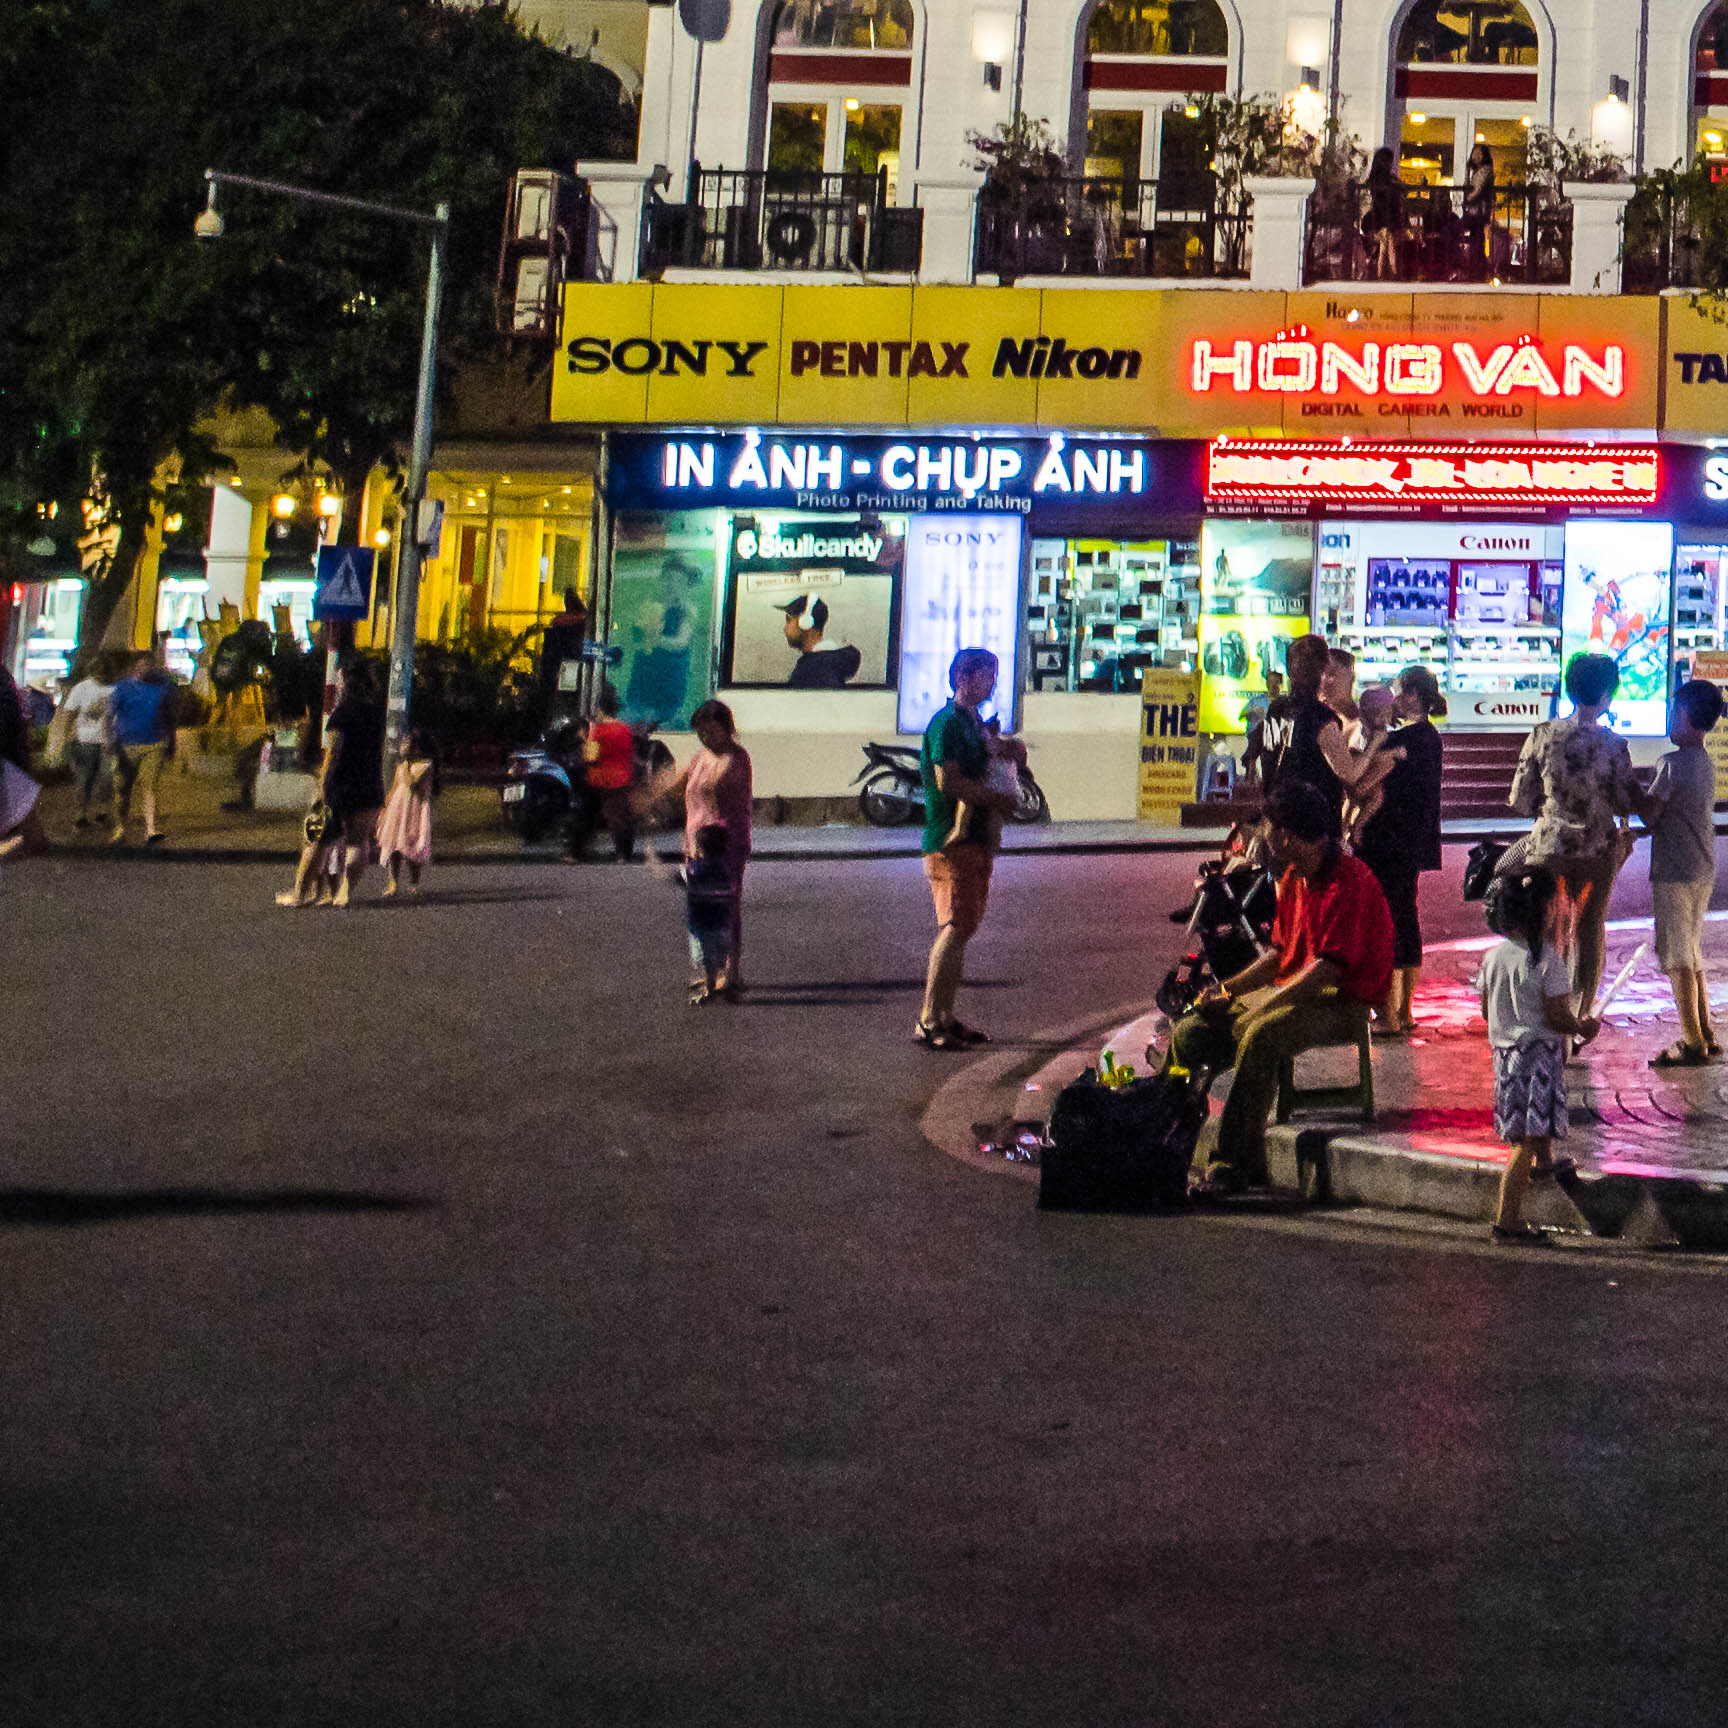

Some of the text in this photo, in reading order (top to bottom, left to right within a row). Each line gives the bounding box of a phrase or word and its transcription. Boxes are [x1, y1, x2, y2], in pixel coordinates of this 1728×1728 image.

[567, 337, 769, 377] SONY
[790, 340, 970, 379] PENTAX
[992, 335, 1142, 381] Nikon
[1452, 335, 1624, 398] VÂN
[1301, 402, 1524, 418] DIGITAL CAMERA WORLD
[664, 442, 714, 488] IN
[729, 426, 844, 491] ẢNH
[882, 445, 1023, 501] CHỤP
[1035, 432, 1144, 494] ẢNH
[796, 493, 1032, 515] Photo Printing and Taking
[757, 532, 884, 563] Skullcandy
[925, 531, 1004, 546] SONY
[1459, 534, 1531, 552] Canon
[1143, 692, 1197, 737] THẺ
[1473, 699, 1540, 717] Canon
